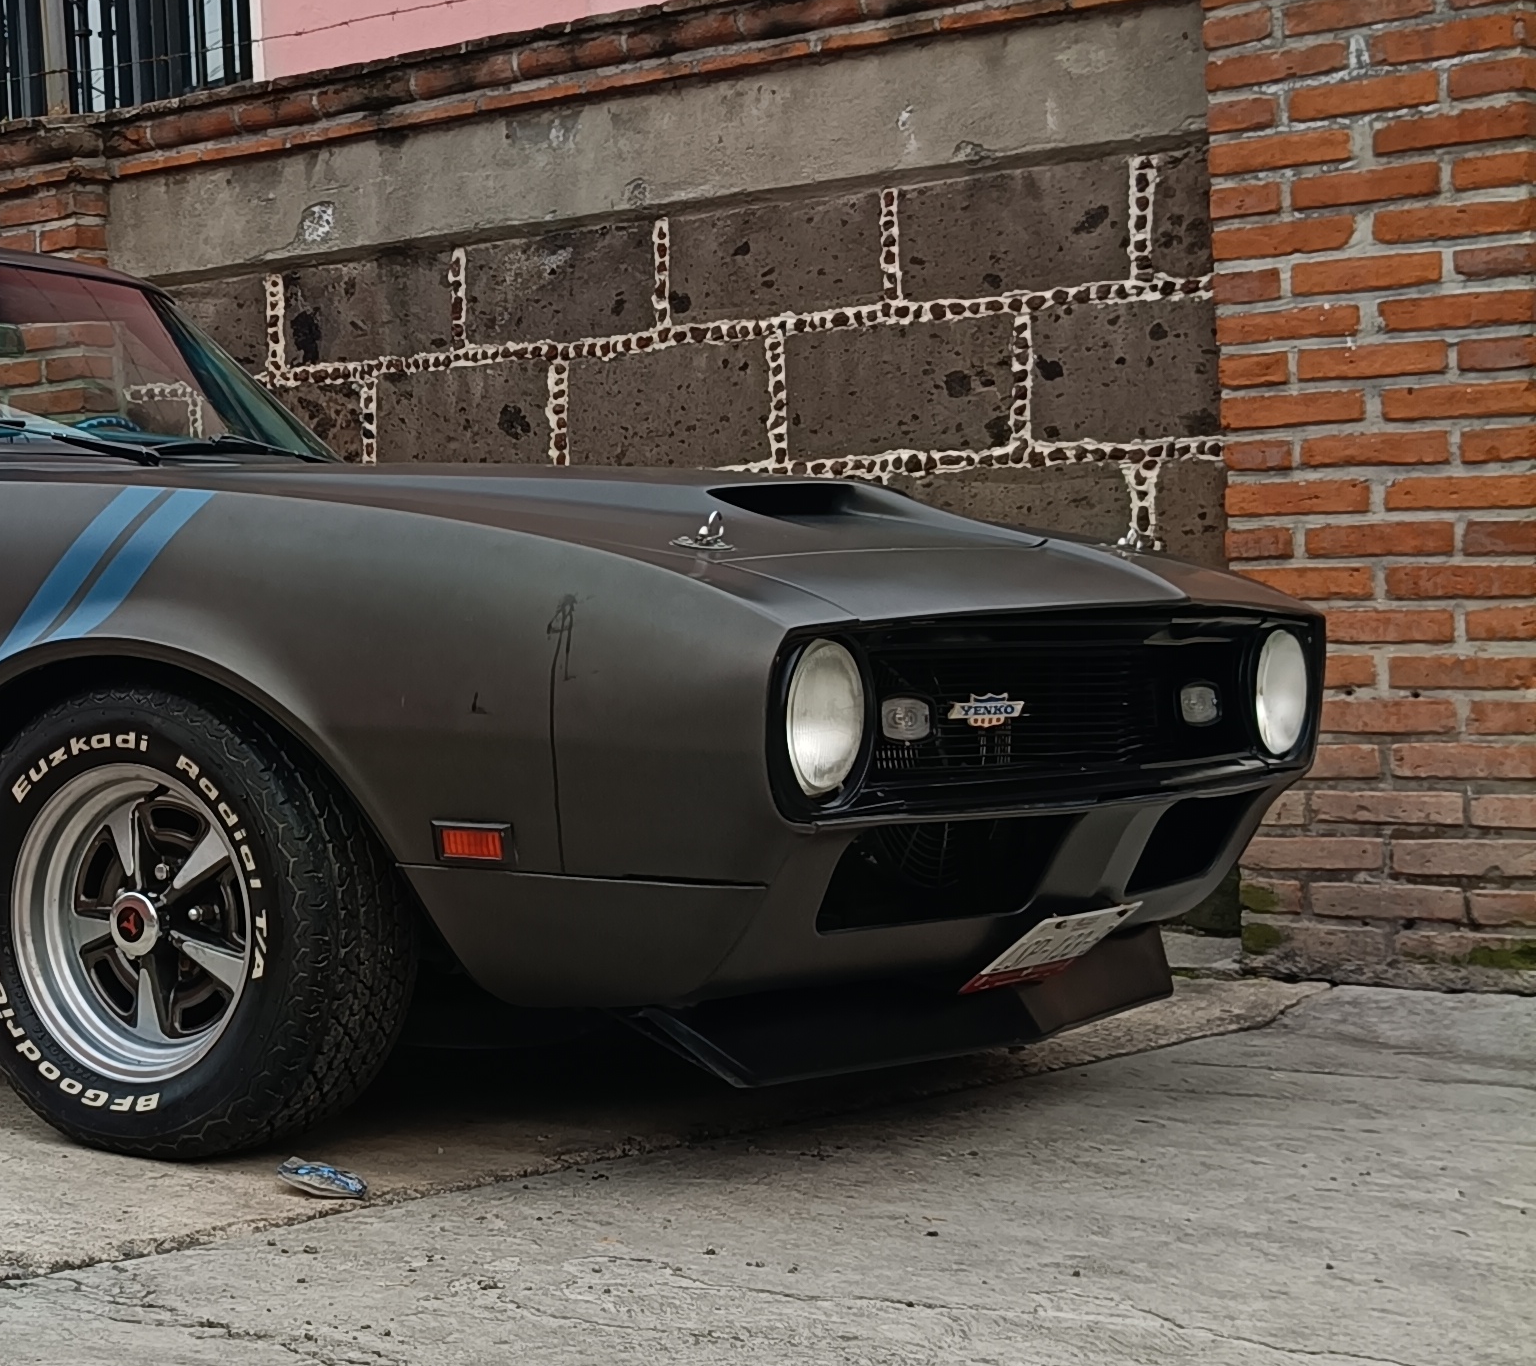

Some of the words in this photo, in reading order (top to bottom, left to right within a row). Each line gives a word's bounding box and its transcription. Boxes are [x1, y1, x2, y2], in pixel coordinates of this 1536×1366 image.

[961, 704, 1016, 716] YENKO
[11, 731, 149, 803] Euzkadi
[176, 754, 261, 889] Radial
[251, 909, 268, 979] T/A
